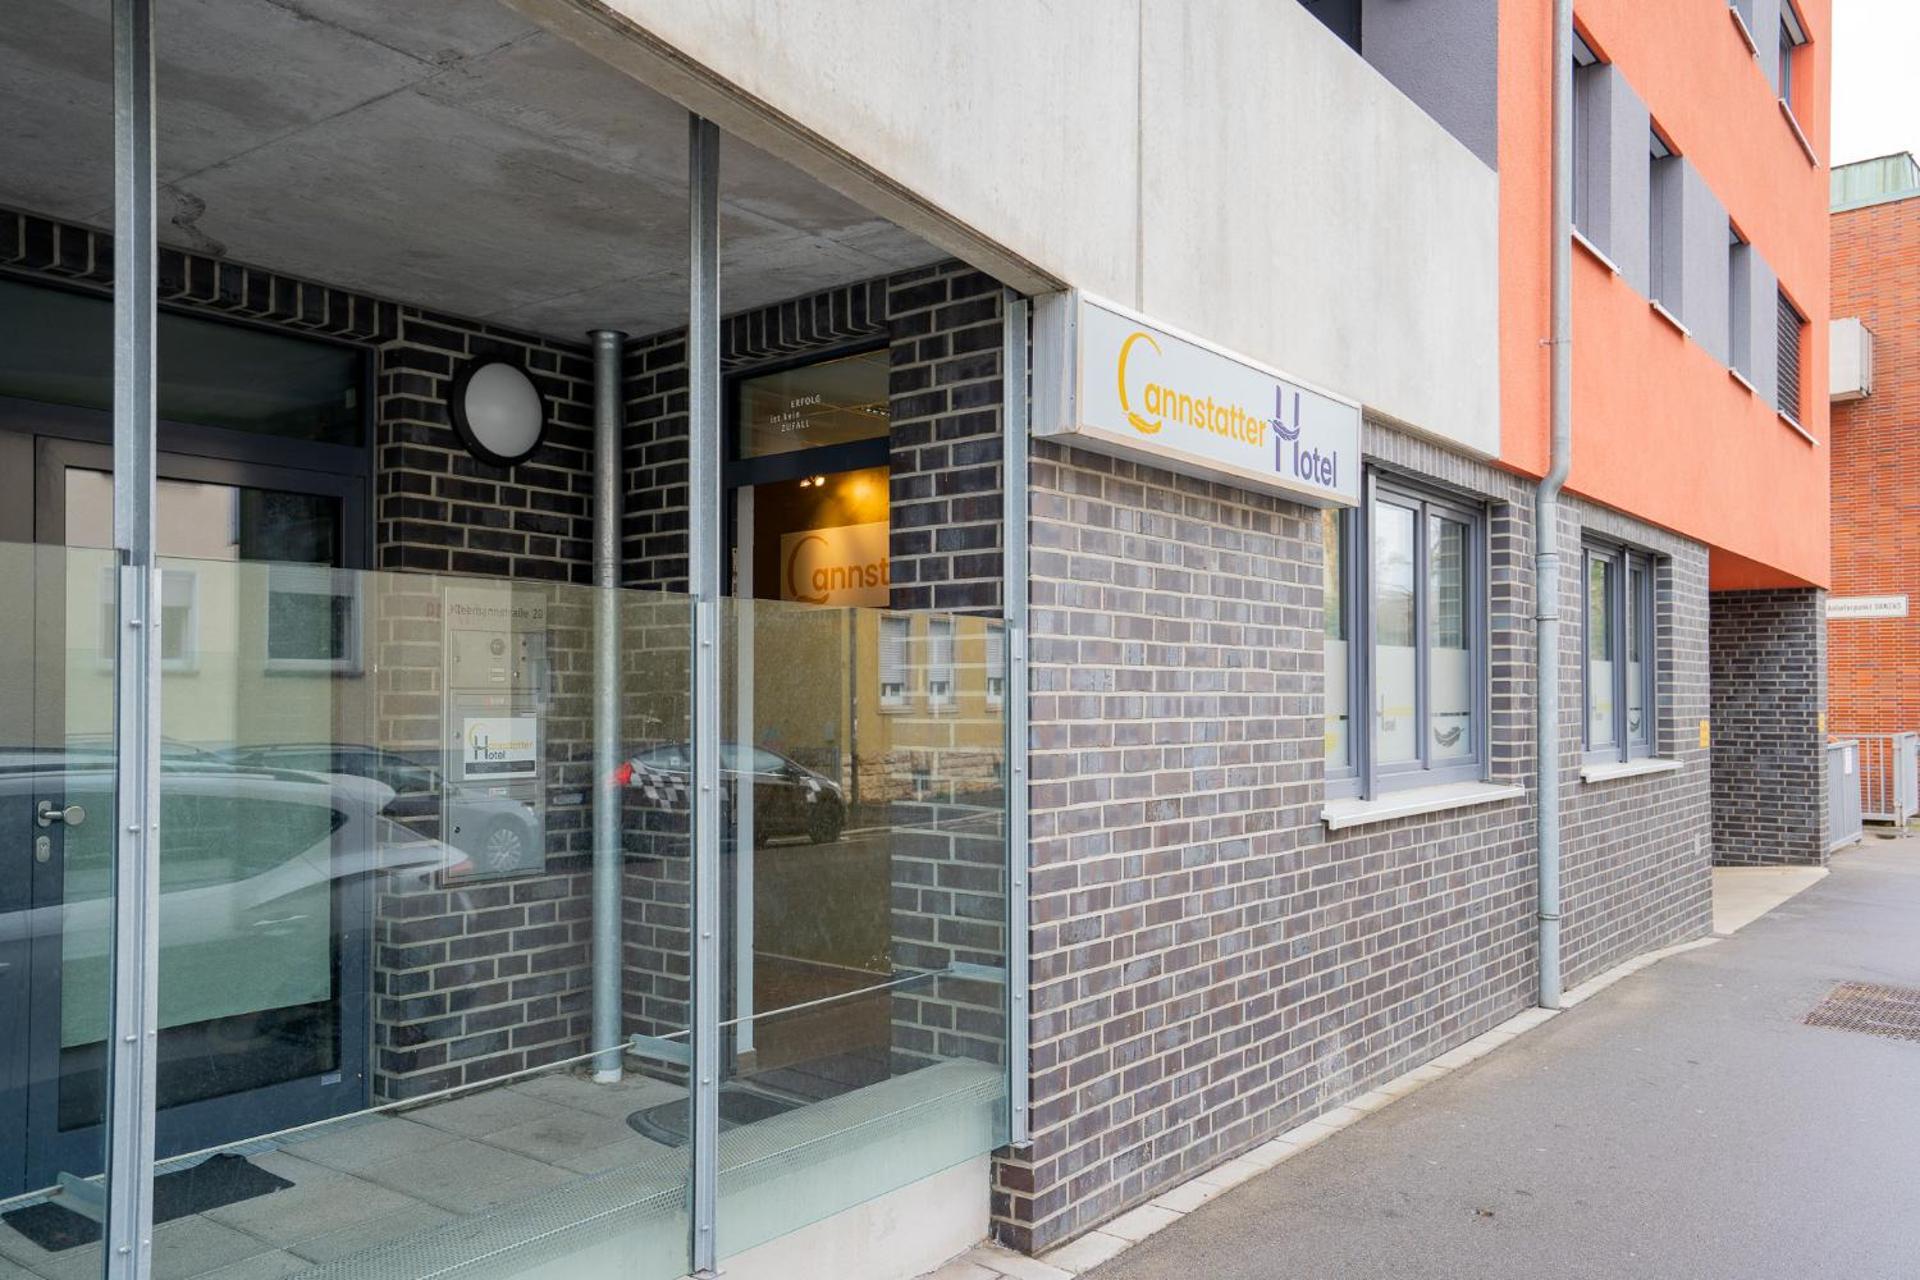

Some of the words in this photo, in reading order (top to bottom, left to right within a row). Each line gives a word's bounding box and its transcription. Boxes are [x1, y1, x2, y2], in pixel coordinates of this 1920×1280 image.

[790, 394, 821, 408] ERFOLG
[1118, 332, 1266, 448] Cannstatter
[1269, 385, 1337, 488] Hotel
[781, 419, 810, 433] ZUFALL
[473, 735, 506, 760] Hotel
